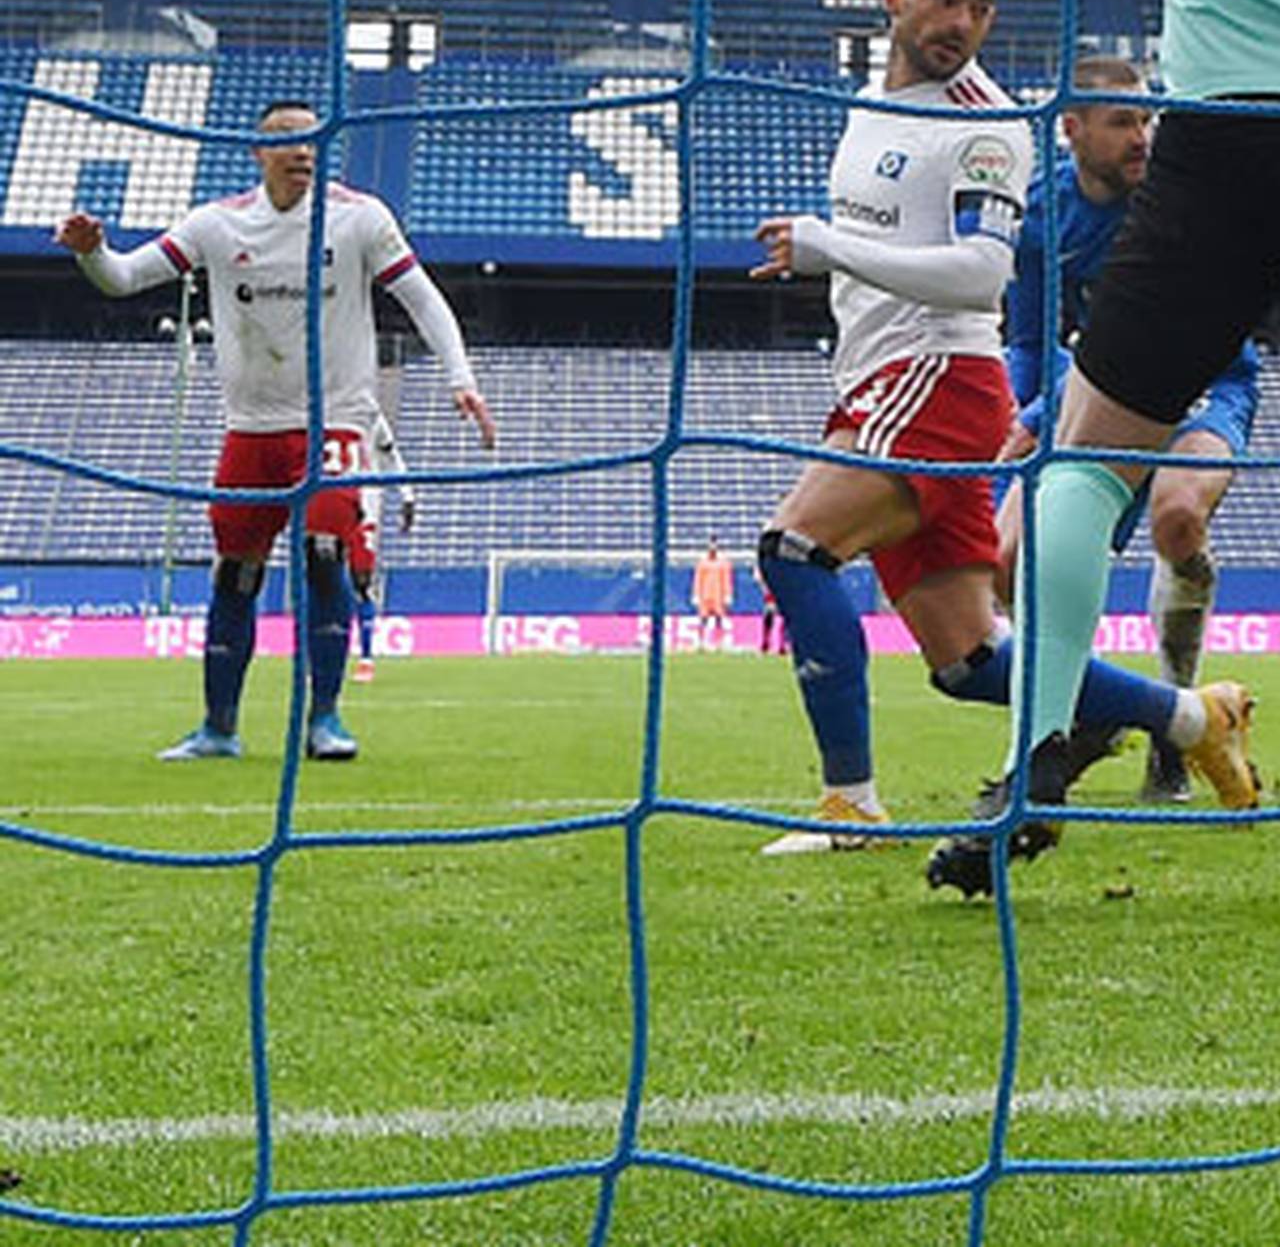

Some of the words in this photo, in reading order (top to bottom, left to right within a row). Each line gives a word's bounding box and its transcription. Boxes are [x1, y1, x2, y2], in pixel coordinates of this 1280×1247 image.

[2, 58, 214, 229] H
[568, 76, 686, 239] S
[1211, 614, 1269, 652] 5G
